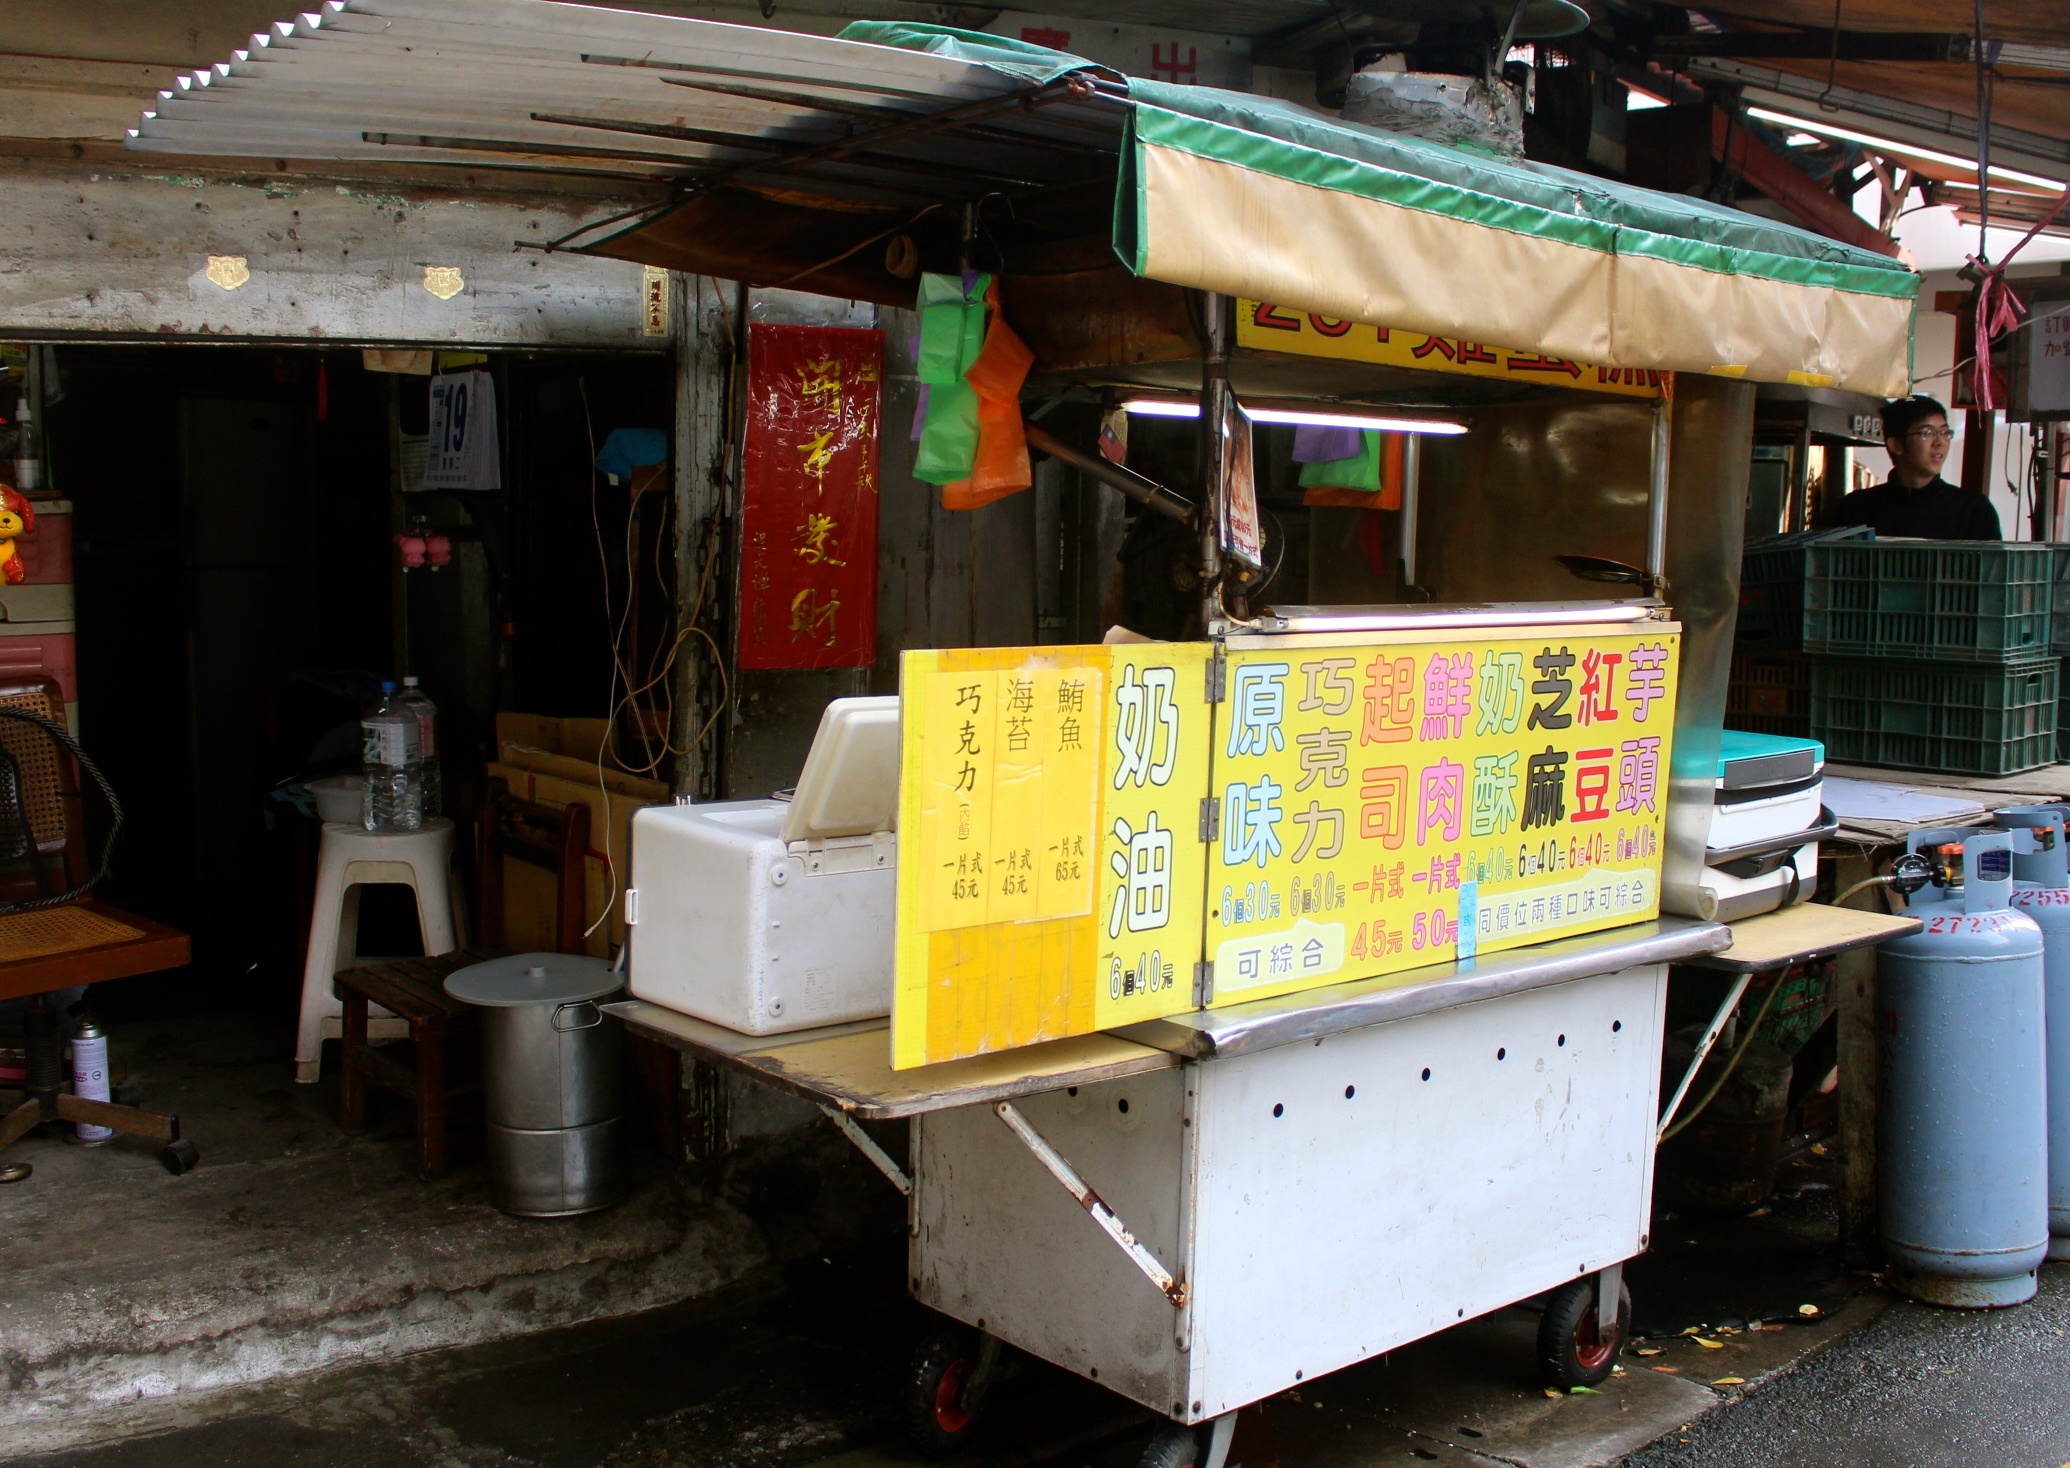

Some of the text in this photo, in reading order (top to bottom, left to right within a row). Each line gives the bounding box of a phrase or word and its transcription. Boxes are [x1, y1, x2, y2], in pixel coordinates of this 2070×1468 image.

[444, 382, 468, 453] 19
[953, 683, 982, 793] 巧克力
[1005, 678, 1034, 753] 海苔
[1056, 678, 1085, 753] 鮪魚
[1520, 646, 1576, 832] 芝麻
[1569, 647, 1624, 824] 紅豆
[1615, 642, 1668, 816] 芋頭
[1222, 661, 1290, 869] 原味
[1290, 656, 1357, 864] 巧克力
[1359, 653, 1416, 851] 起司
[1417, 651, 1474, 847] 鮮肉
[1470, 649, 1525, 838] 奶酥
[1109, 663, 1179, 940] 奶油
[942, 850, 983, 876] 一片式
[994, 847, 1032, 873] 一片式
[1048, 834, 1085, 858] 一片式
[1466, 845, 1513, 884] 6個40元
[1518, 838, 1566, 877] 6個40元
[1568, 832, 1612, 869] 6個40元
[1616, 824, 1658, 862] 6個40元
[951, 877, 981, 901] 45元
[1001, 874, 1030, 897] 45元
[1055, 859, 1082, 883] 65元
[1289, 872, 1346, 917] 6個30元
[1352, 861, 1405, 903] 一片式
[1411, 852, 1461, 896] 一片式
[1221, 879, 1281, 928] 6個30元
[1477, 879, 1645, 935] 同價位兩種口味可綜合
[1351, 918, 1403, 961] 45元
[1411, 908, 1460, 951] 50元
[1109, 948, 1174, 1000] 6個40元
[1237, 937, 1325, 980] 可綜合
